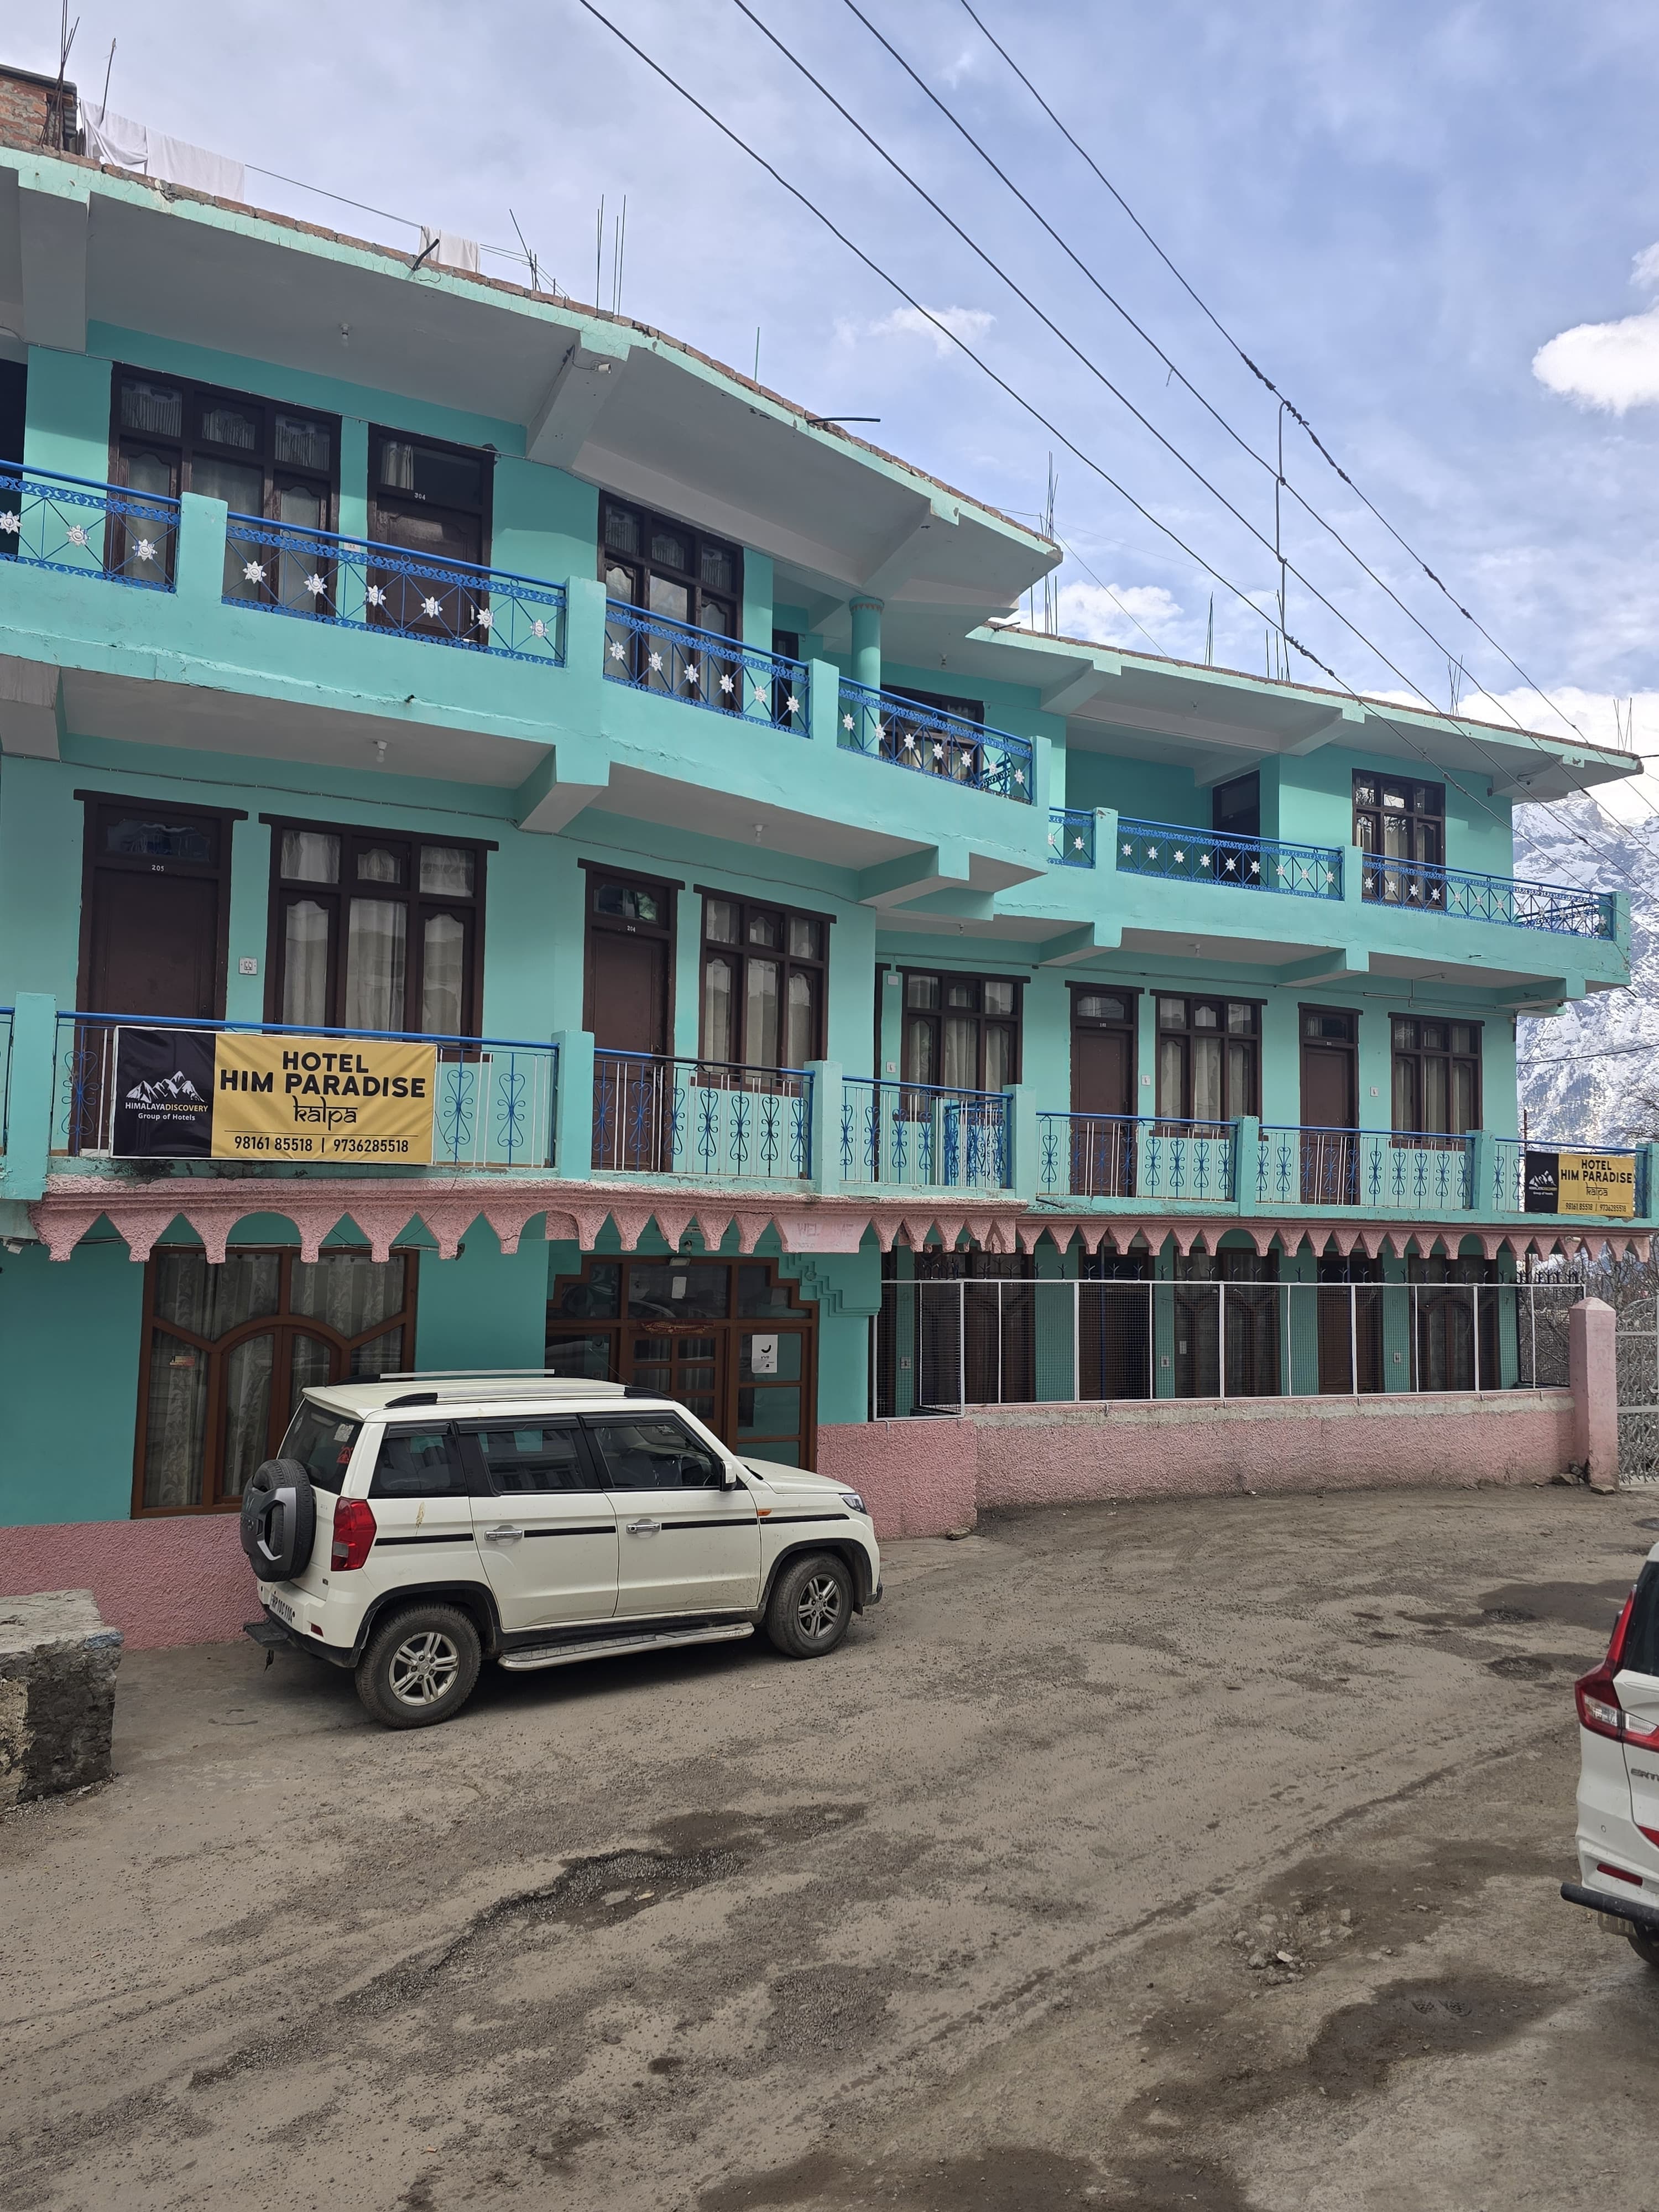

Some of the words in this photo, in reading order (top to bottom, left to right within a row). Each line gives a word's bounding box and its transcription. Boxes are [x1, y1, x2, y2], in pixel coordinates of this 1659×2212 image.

[283, 1051, 369, 1073] HOTEL
[220, 1069, 274, 1093] HIM
[285, 1073, 426, 1098] PARADISE
[125, 1102, 208, 1113] HIMALAYADISCOVERY
[291, 1095, 358, 1131] kalpa
[138, 1113, 160, 1121] Group
[234, 1136, 270, 1150] 98161
[274, 1137, 312, 1152] 85518
[333, 1139, 409, 1153] 9736285518
[1581, 1159, 1612, 1171] HOTEL
[1561, 1169, 1579, 1181] HIM
[1583, 1170, 1632, 1183] PARADISE
